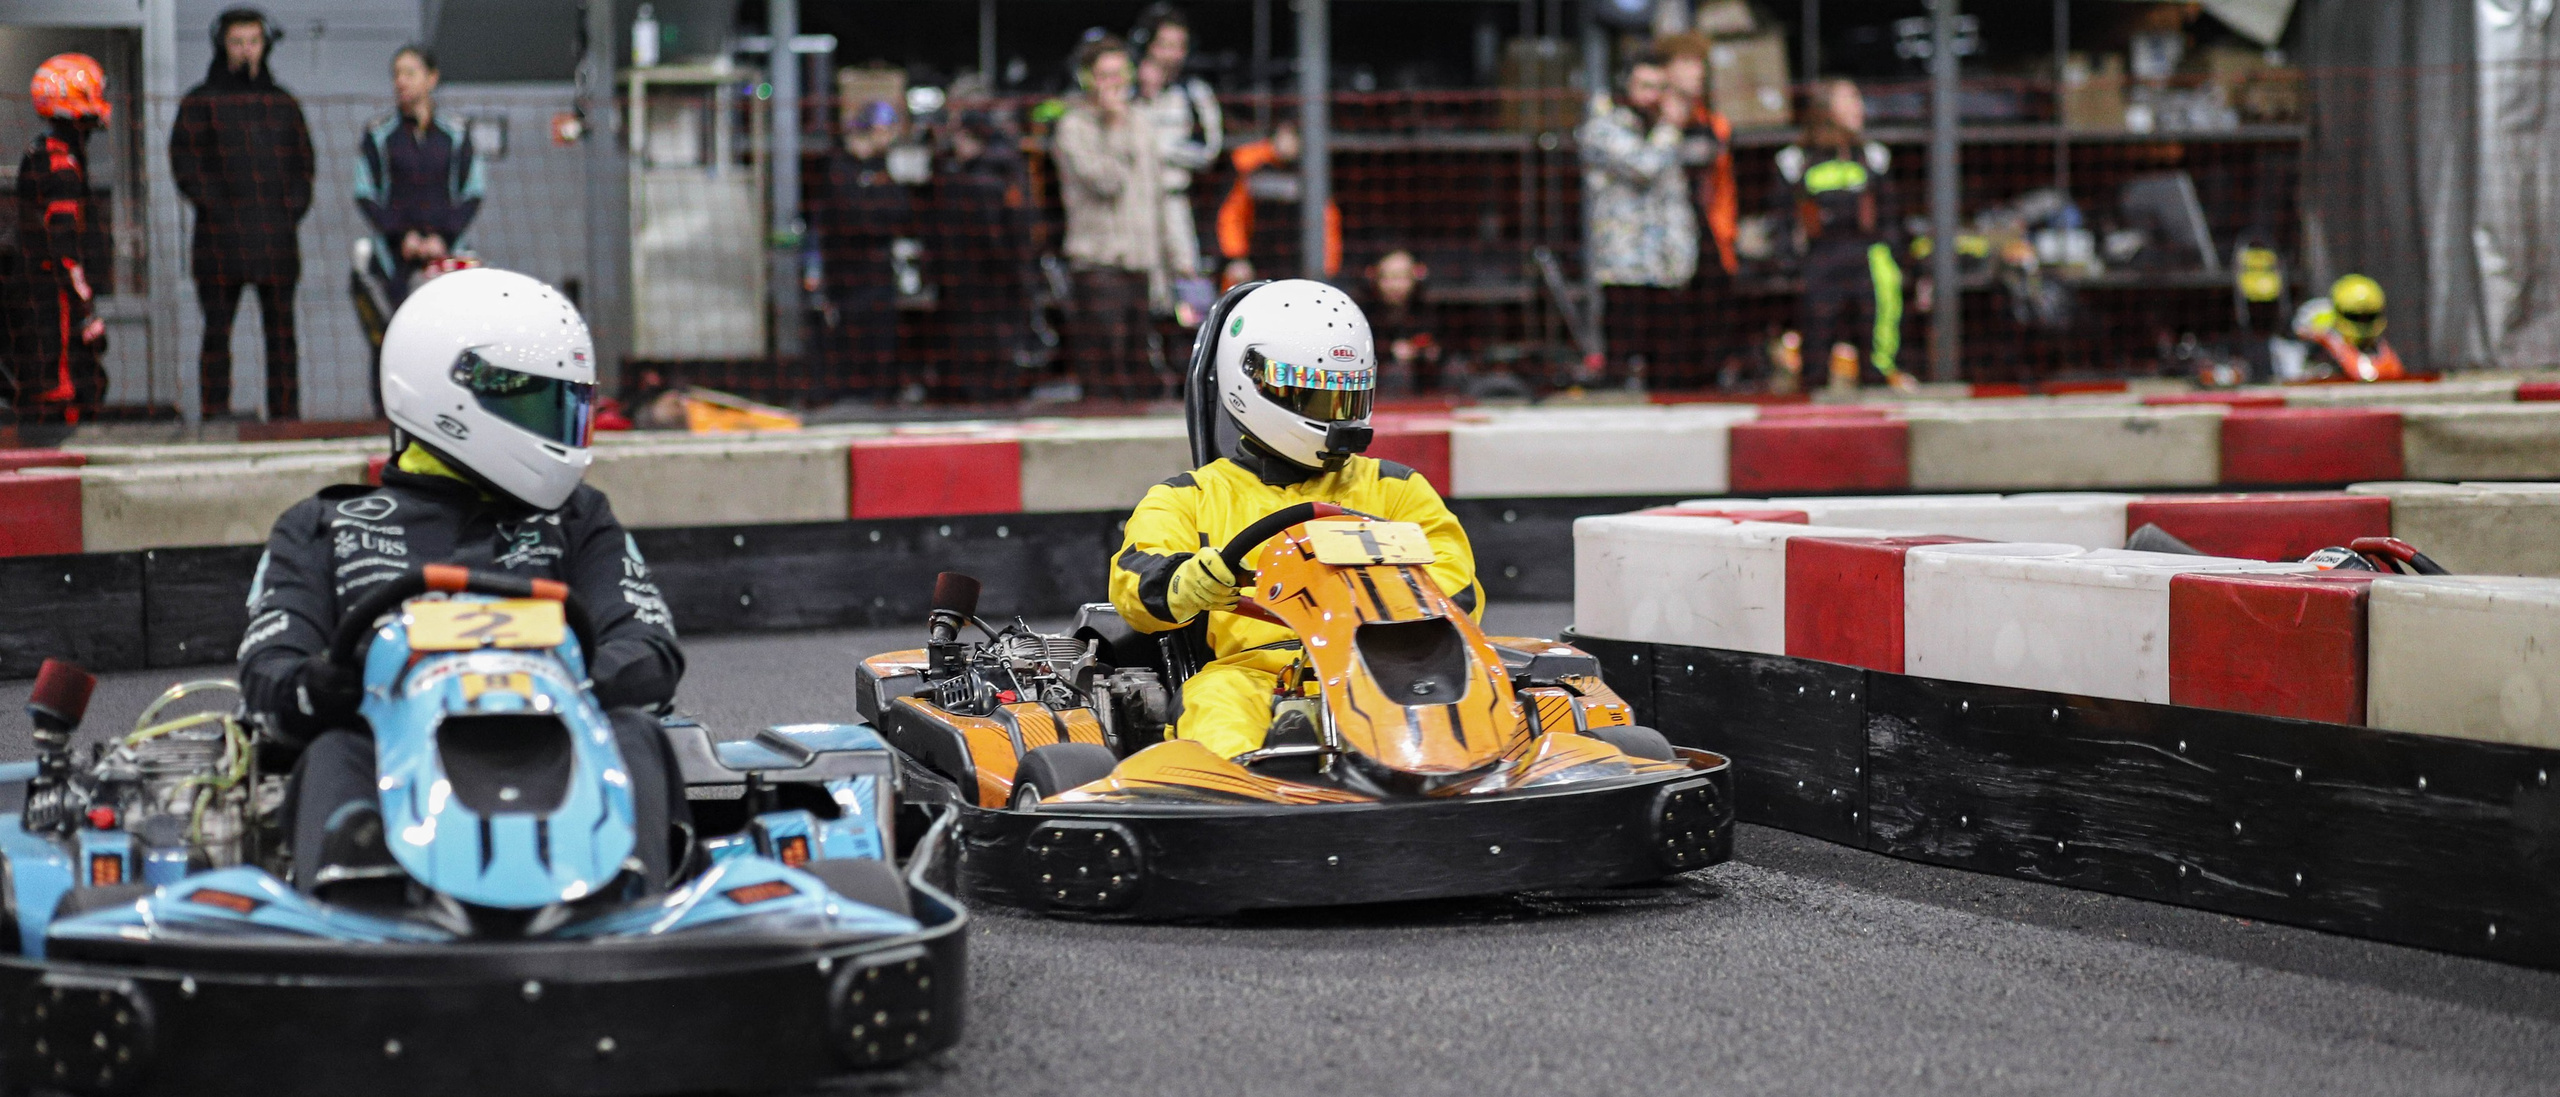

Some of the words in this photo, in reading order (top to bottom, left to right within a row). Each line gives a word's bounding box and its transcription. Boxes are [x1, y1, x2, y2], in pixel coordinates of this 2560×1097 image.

[1332, 349, 1355, 358] BELL
[361, 531, 409, 557] UBS
[453, 611, 520, 639] 2
